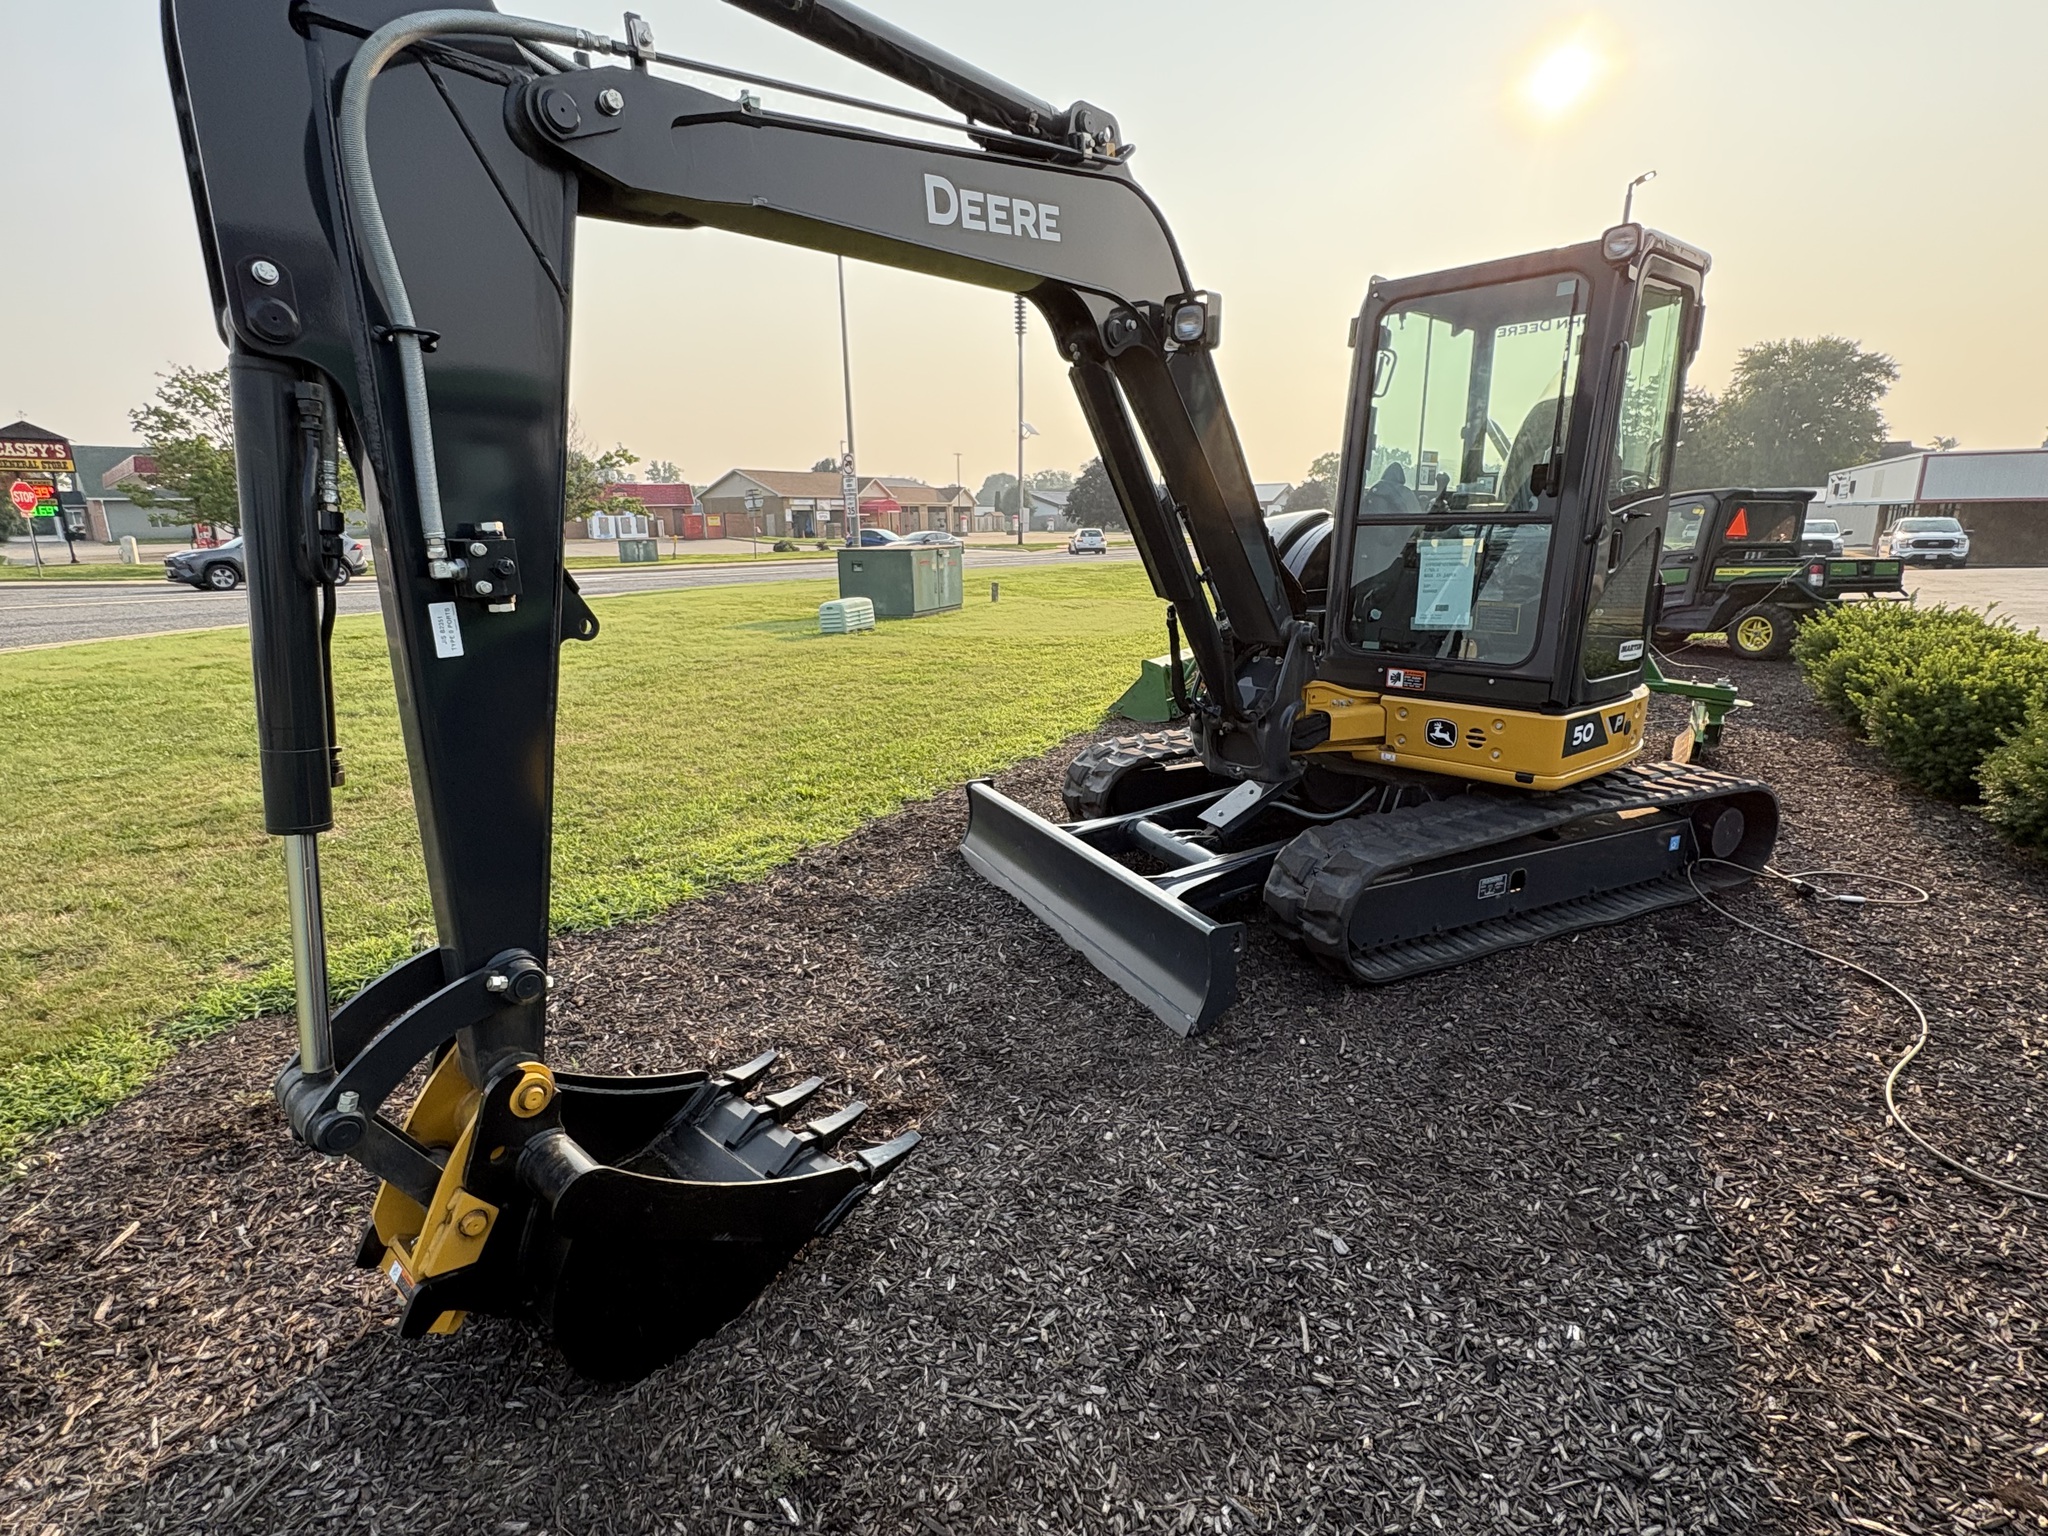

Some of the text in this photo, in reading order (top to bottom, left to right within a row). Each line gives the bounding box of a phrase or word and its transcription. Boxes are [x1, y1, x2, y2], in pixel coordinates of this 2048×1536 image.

[924, 173, 1061, 242] DEERE
[14, 491, 34, 503] STOP
[847, 507, 855, 515] 35
[1572, 714, 1624, 746] 50 P
